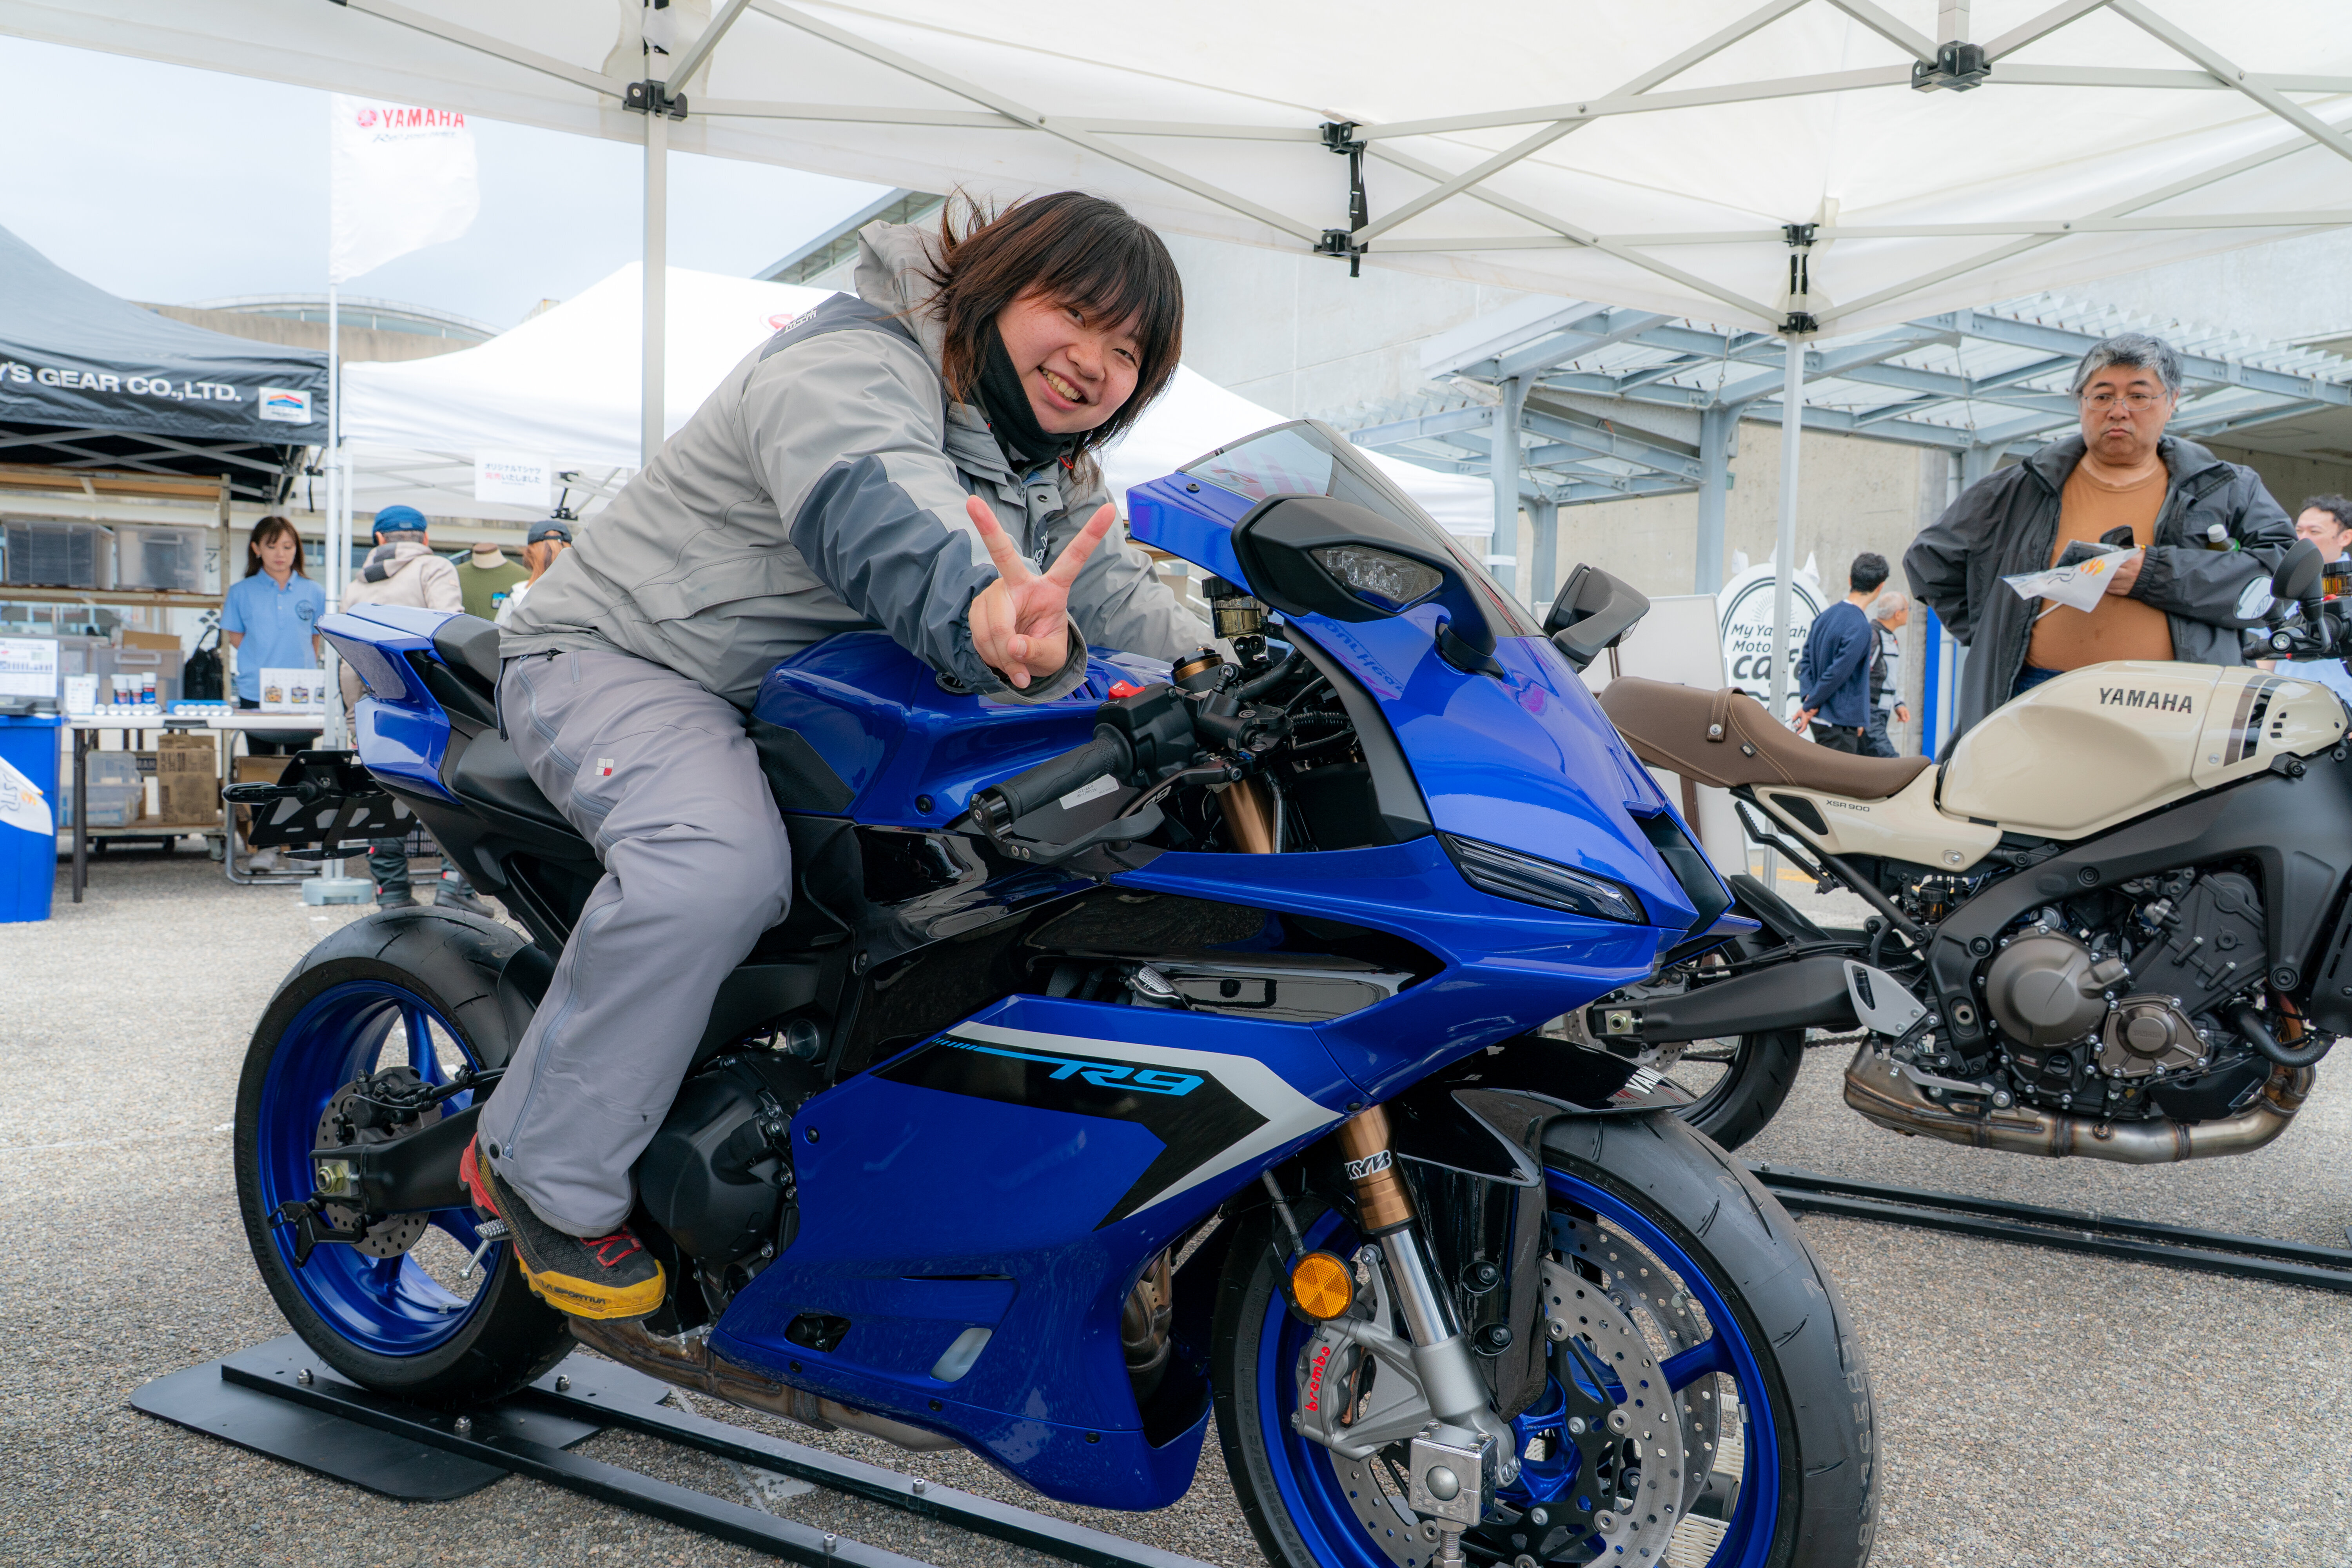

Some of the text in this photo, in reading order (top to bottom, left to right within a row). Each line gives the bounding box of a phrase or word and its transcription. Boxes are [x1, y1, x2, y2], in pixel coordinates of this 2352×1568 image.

[382, 108, 464, 128] YAMAHA
[37, 368, 120, 392] GEAR
[127, 377, 242, 401] CO.,LTD.
[1731, 624, 1807, 638] My Yaah
[1733, 640, 1773, 652] Moto
[2100, 688, 2192, 714] YAMAHA
[1826, 800, 1847, 808] XSR
[1344, 1149, 1392, 1180] KYB
[541, 1281, 606, 1305] LA SPORTIVA
[1305, 1346, 1330, 1412] brembo
